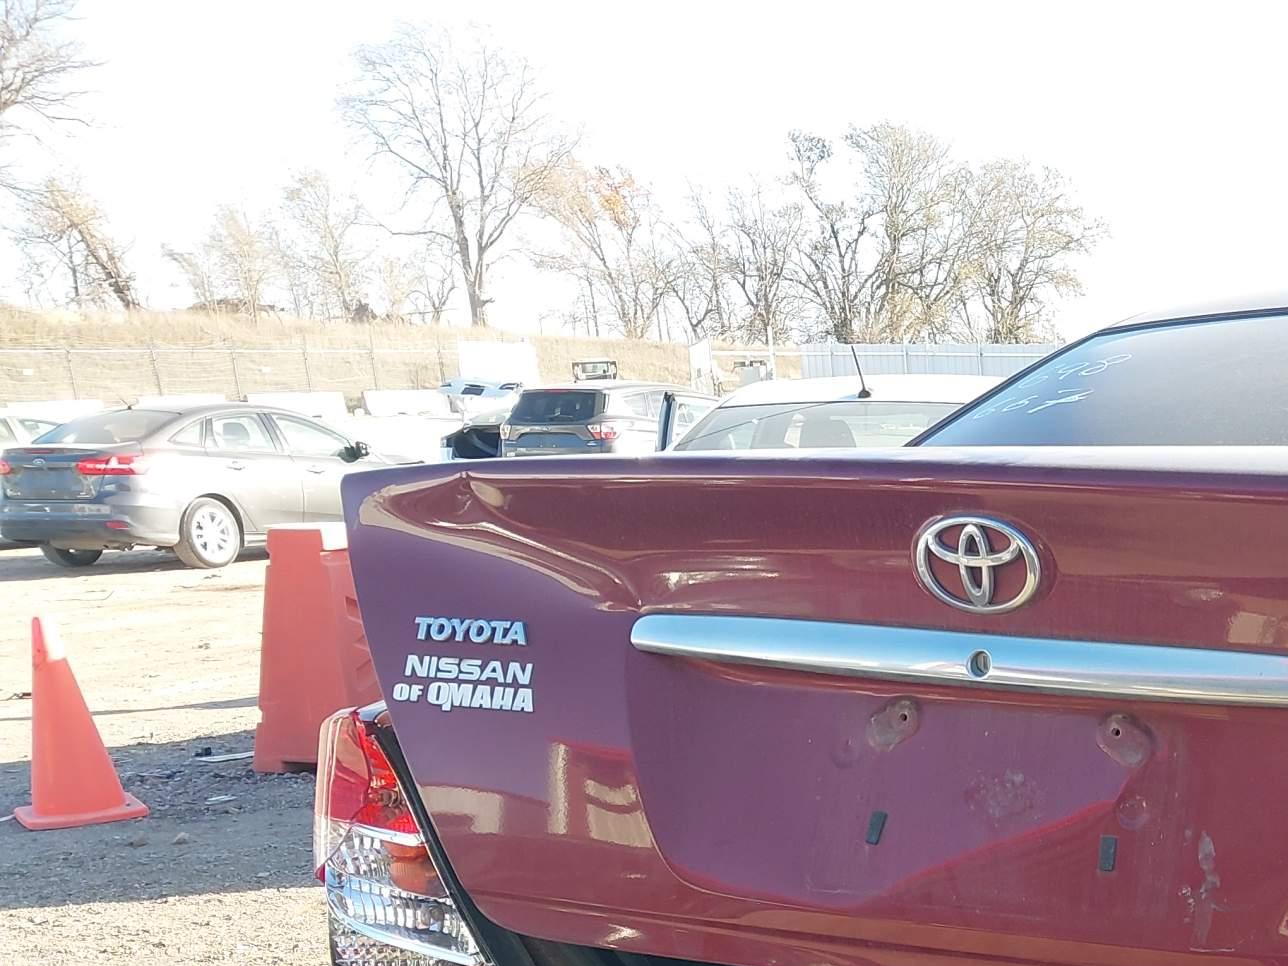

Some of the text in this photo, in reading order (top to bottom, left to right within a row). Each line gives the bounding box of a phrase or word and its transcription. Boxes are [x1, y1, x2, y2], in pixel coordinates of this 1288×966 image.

[414, 616, 527, 645] TOYOTA
[404, 654, 533, 685] NISSAN
[392, 682, 534, 712] OF OMAHA
